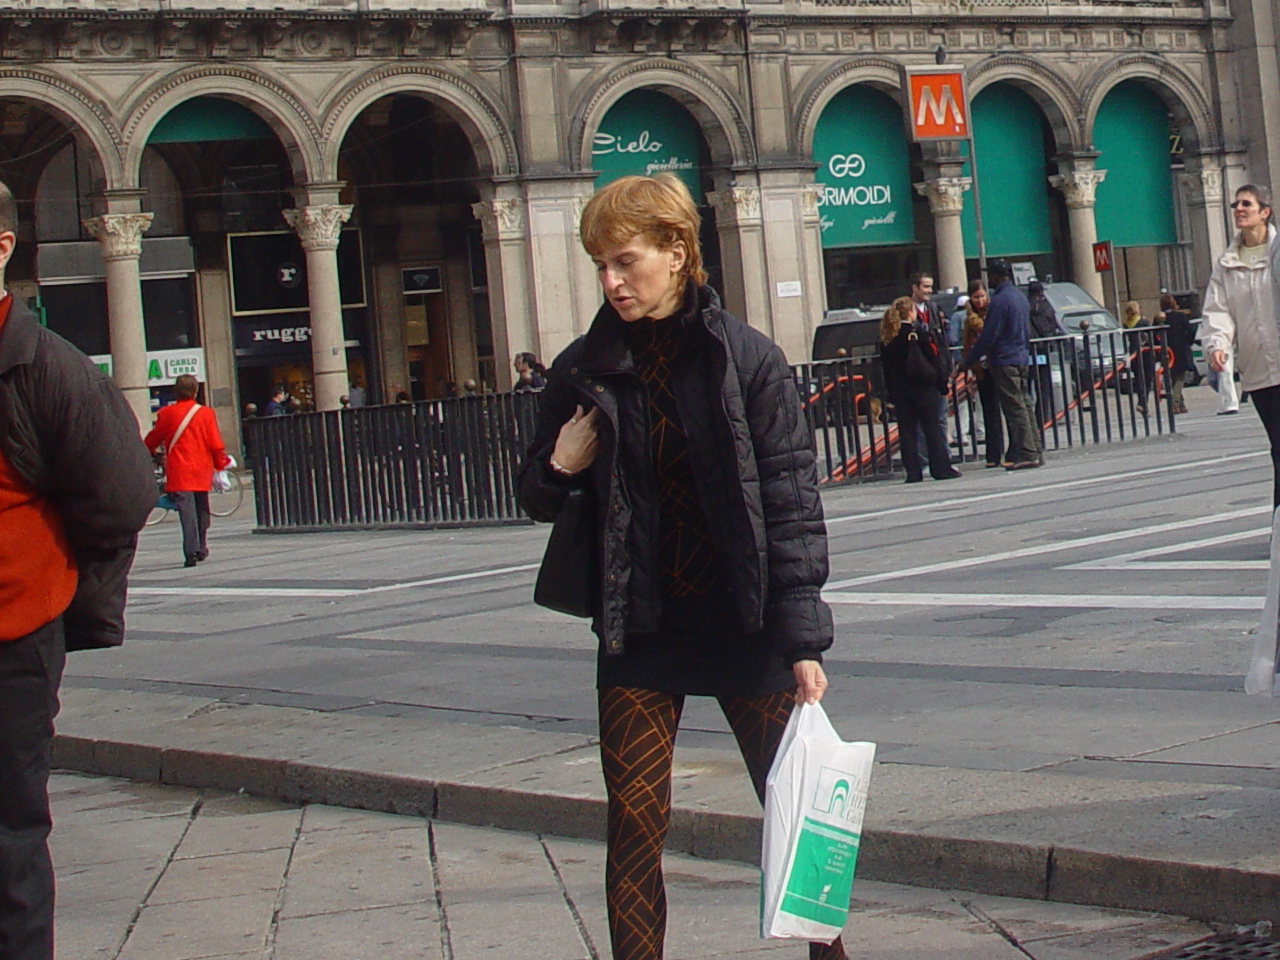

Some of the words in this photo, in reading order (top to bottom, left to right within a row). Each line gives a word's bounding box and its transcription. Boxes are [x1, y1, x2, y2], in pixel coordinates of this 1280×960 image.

[917, 84, 965, 126] M
[1096, 248, 1109, 266] M
[169, 358, 198, 367] CARLO
